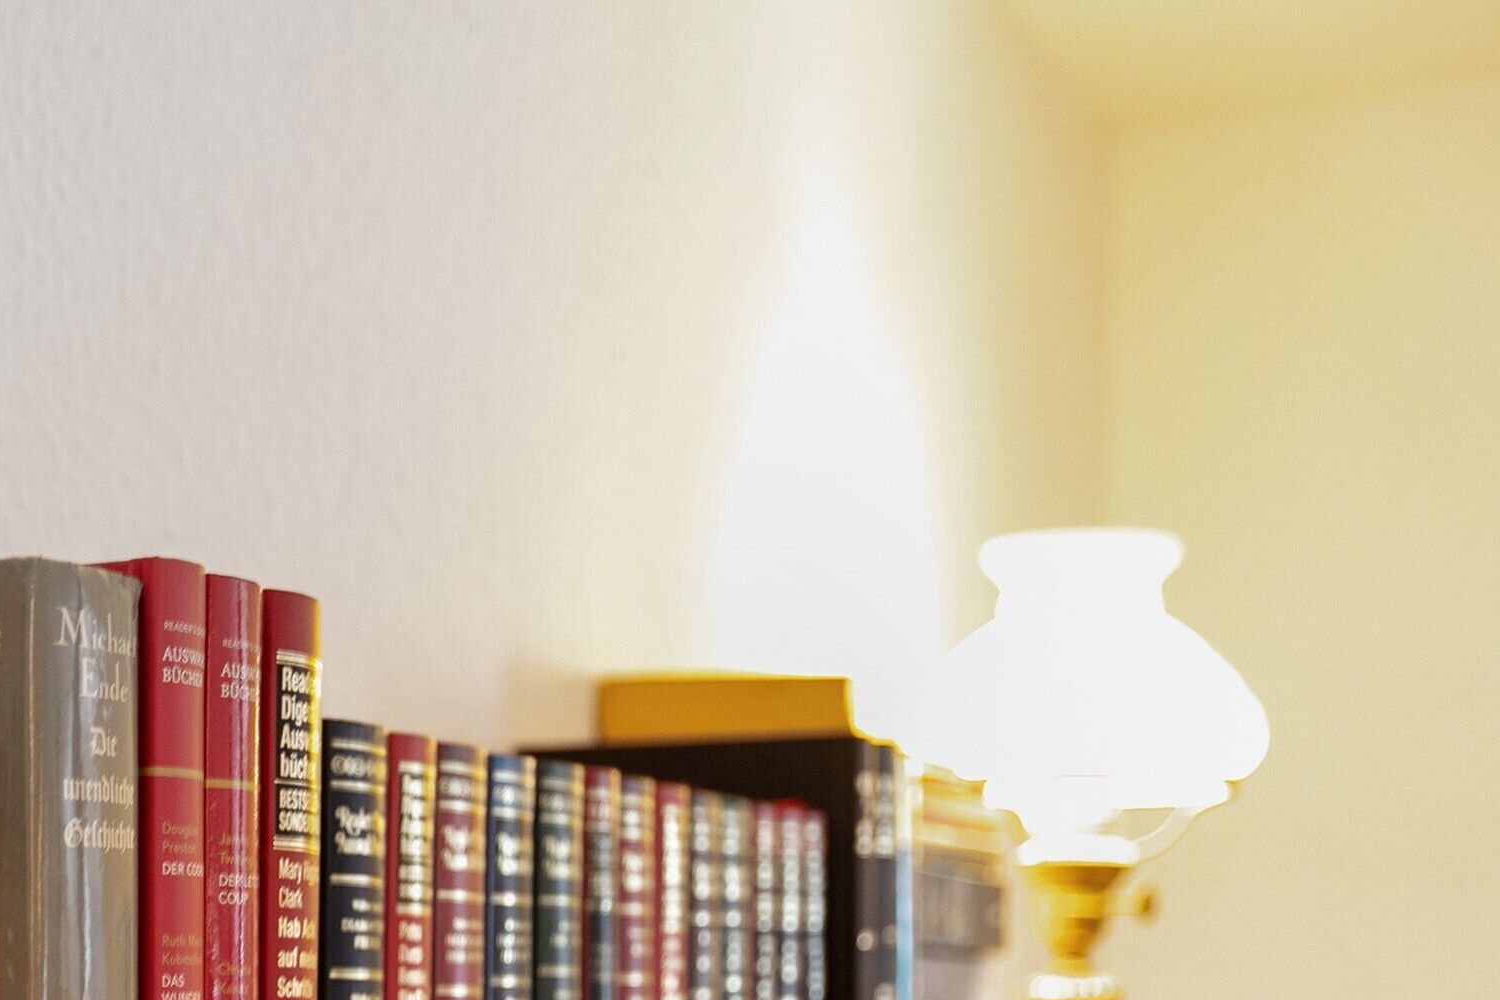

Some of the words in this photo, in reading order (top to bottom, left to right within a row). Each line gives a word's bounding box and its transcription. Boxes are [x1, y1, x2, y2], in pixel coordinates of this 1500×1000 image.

[79, 656, 130, 703] Ende
[90, 725, 118, 758] Die
[162, 861, 186, 876] DER
[218, 872, 243, 888] DER
[218, 890, 249, 905] COUP
[277, 915, 300, 939] Hab
[277, 946, 298, 968] auf
[161, 974, 185, 988] DAS
